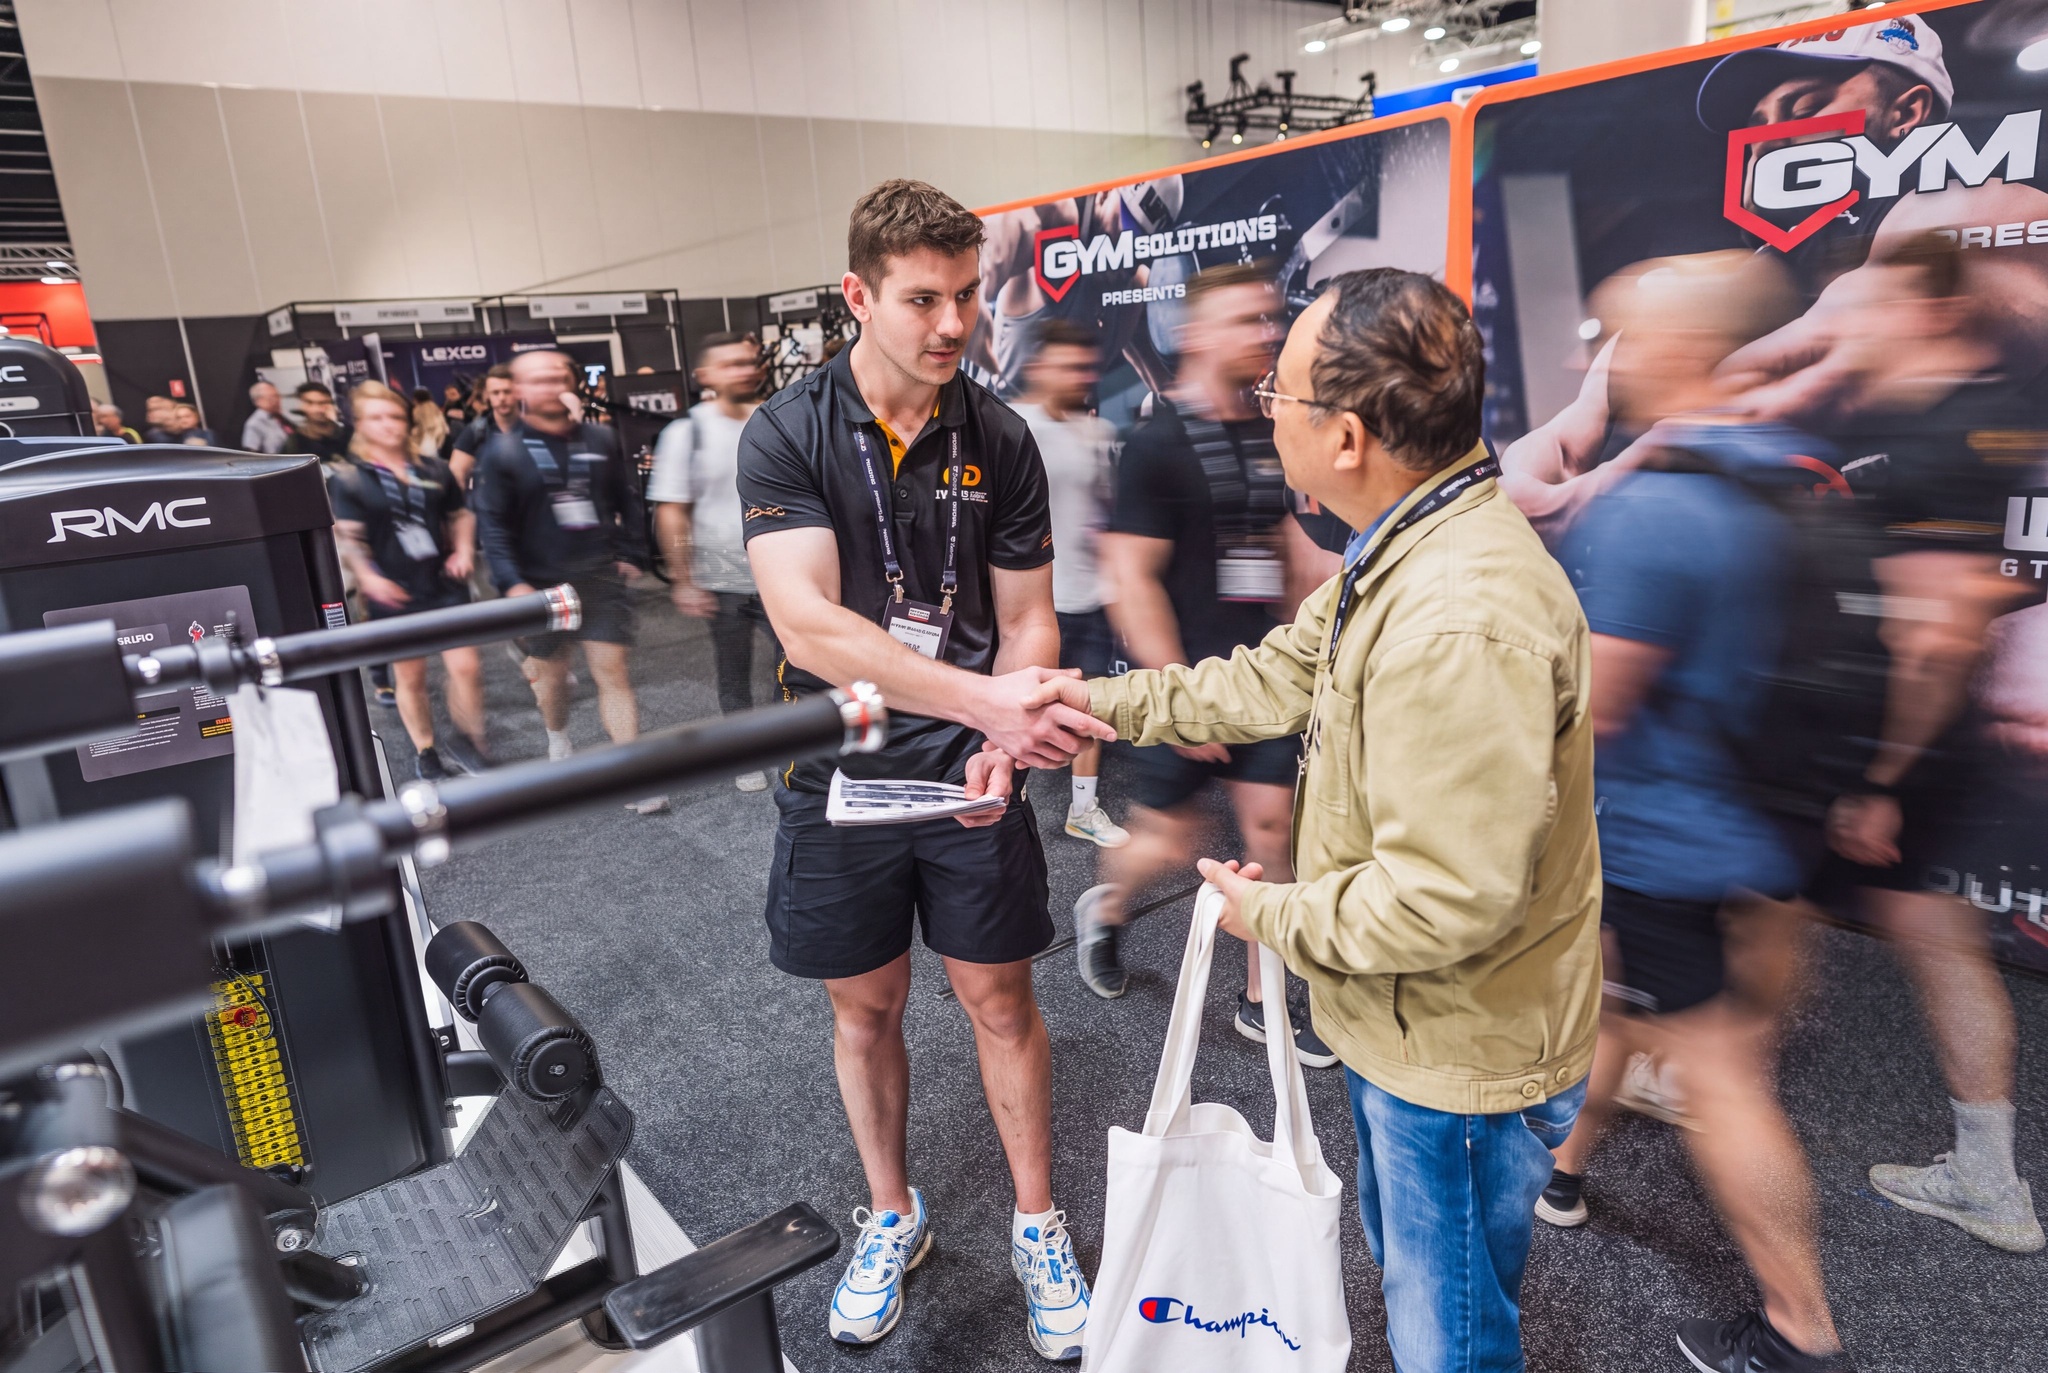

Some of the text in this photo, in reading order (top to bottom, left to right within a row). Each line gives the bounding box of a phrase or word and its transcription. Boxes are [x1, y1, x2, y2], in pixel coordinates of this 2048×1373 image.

[1753, 109, 2042, 210] GYM
[1044, 215, 1277, 279] GYM SOLUTIONS
[1102, 284, 1186, 306] PRESENTS
[47, 497, 211, 543] RMC
